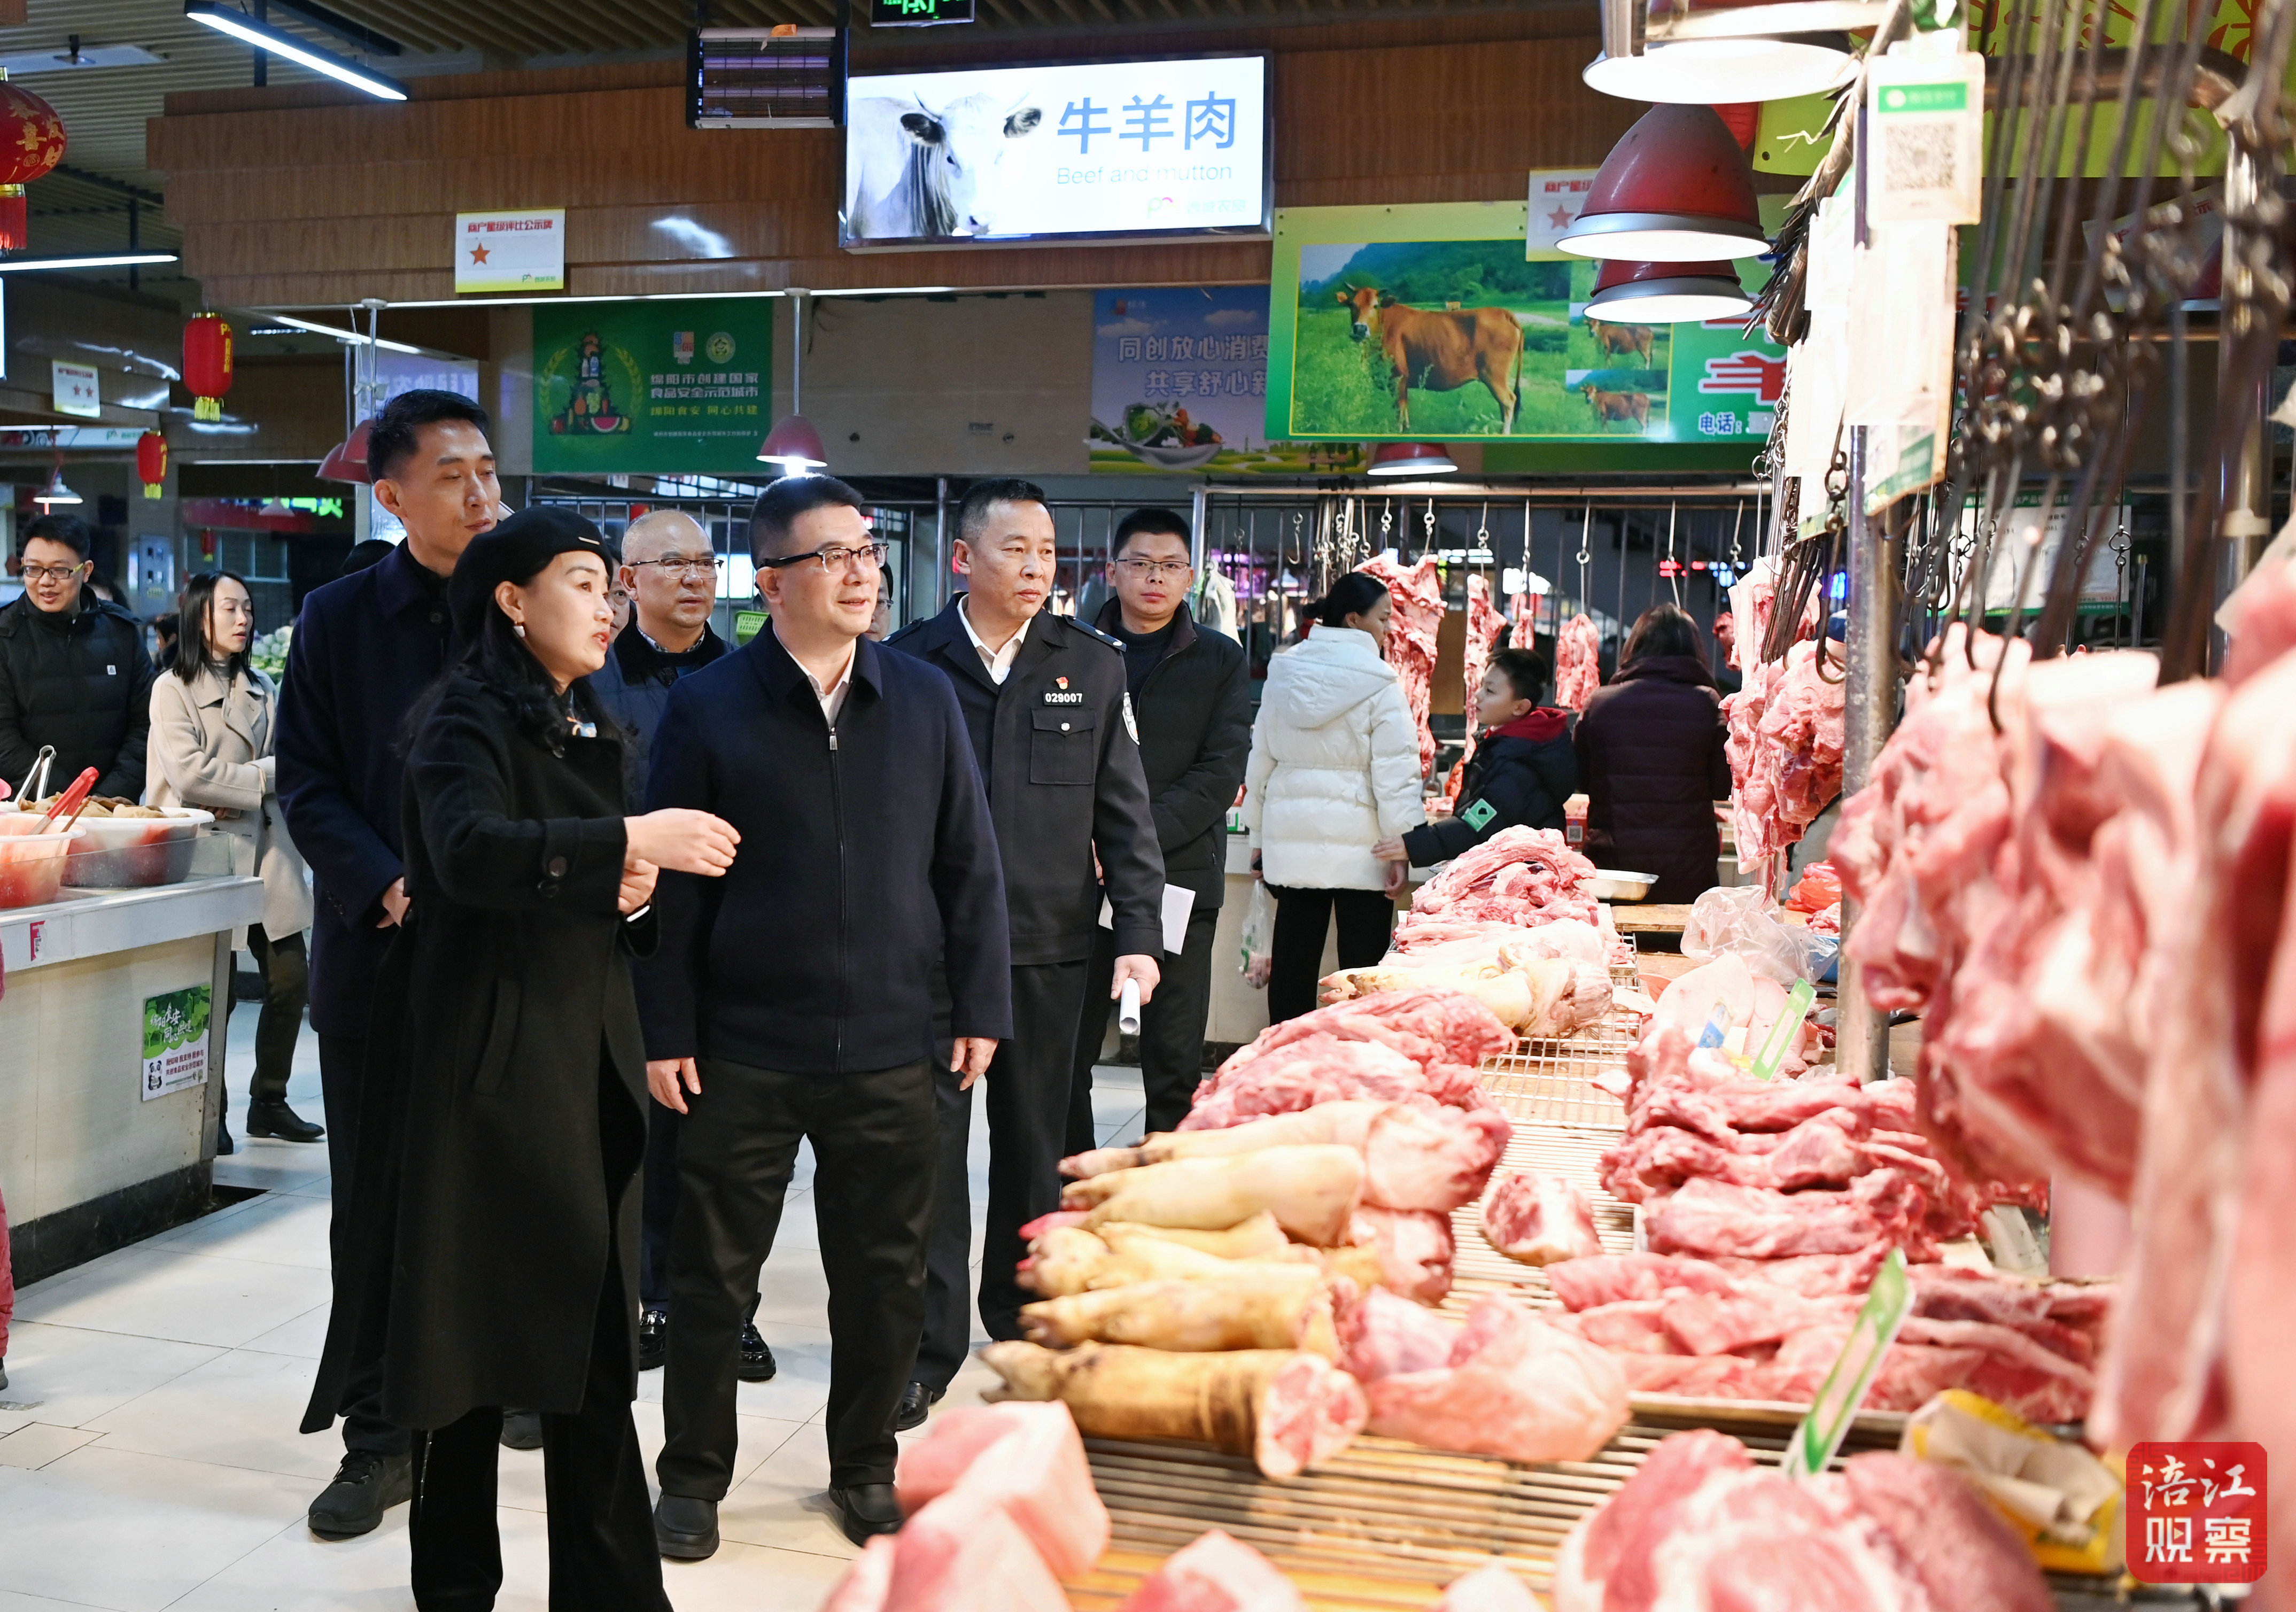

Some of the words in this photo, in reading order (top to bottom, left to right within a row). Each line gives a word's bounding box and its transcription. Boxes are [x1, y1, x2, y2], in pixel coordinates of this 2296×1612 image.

[1057, 91, 1236, 154] 牛羊肉
[1057, 167, 1103, 184] Beef
[1111, 166, 1148, 182] and
[1158, 166, 1232, 181] mutton
[468, 219, 553, 233] 商户星级评比公示牌
[1119, 334, 1268, 362] 同创放心消费
[651, 373, 759, 385] 绵阳市创建国家
[651, 386, 759, 399] 食品安全示范城市
[651, 406, 700, 416] 绵阳食安
[708, 405, 758, 415] 同心共建
[1045, 693, 1083, 703] 029007
